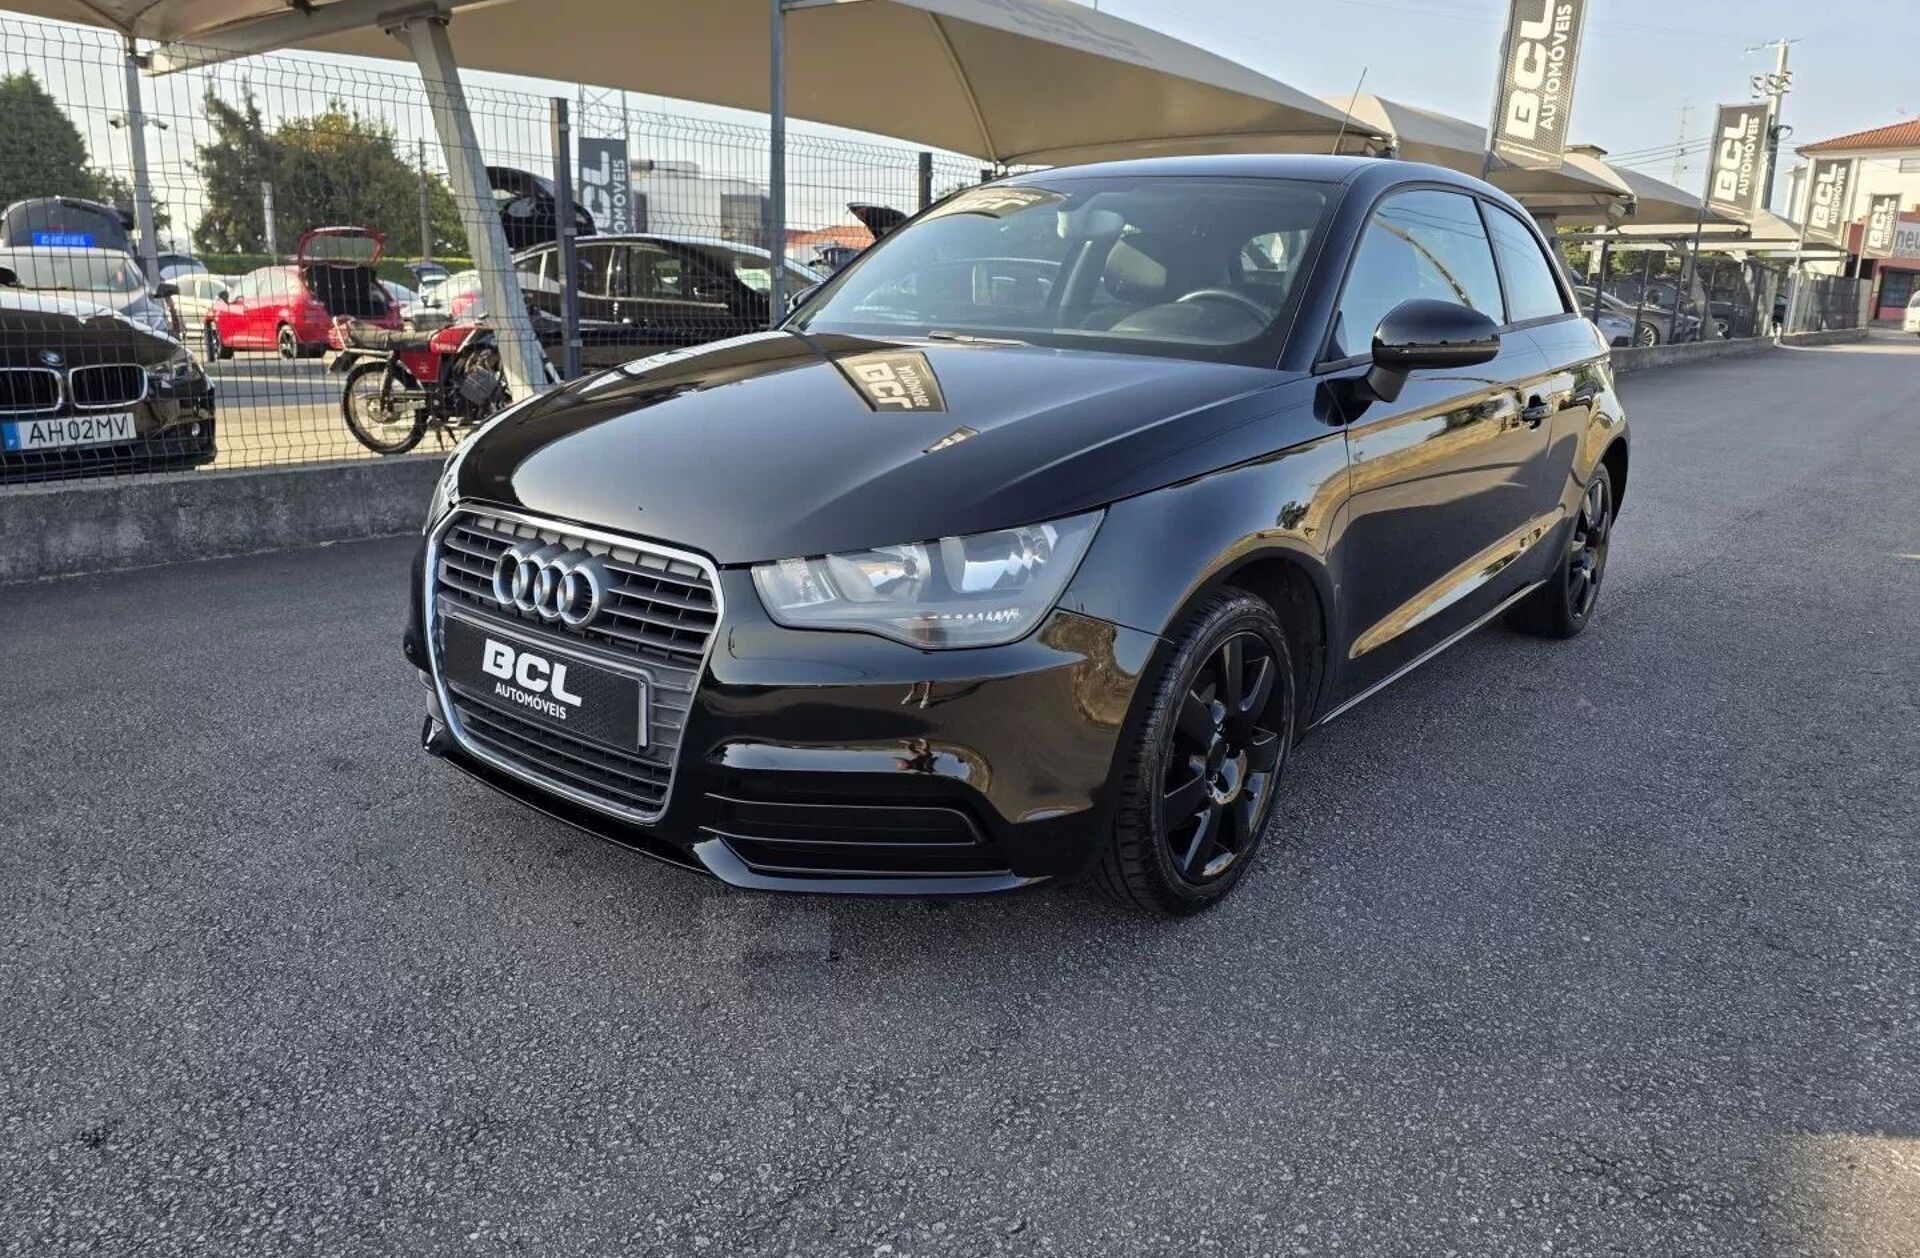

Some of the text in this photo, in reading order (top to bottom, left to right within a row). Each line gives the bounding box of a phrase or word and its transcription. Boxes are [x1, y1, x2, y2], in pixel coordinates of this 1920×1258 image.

[1505, 0, 1555, 140] BCL
[1539, 4, 1573, 130] AUTOMÓVEIS
[582, 151, 611, 236] CL
[1714, 113, 1748, 202] BCL
[1738, 117, 1760, 196] AUTOMÓVEIS
[1811, 163, 1838, 229] BCL
[1868, 197, 1890, 248] BCL
[482, 638, 582, 707] BCL
[495, 682, 566, 719] AUTOMÓVEIS
